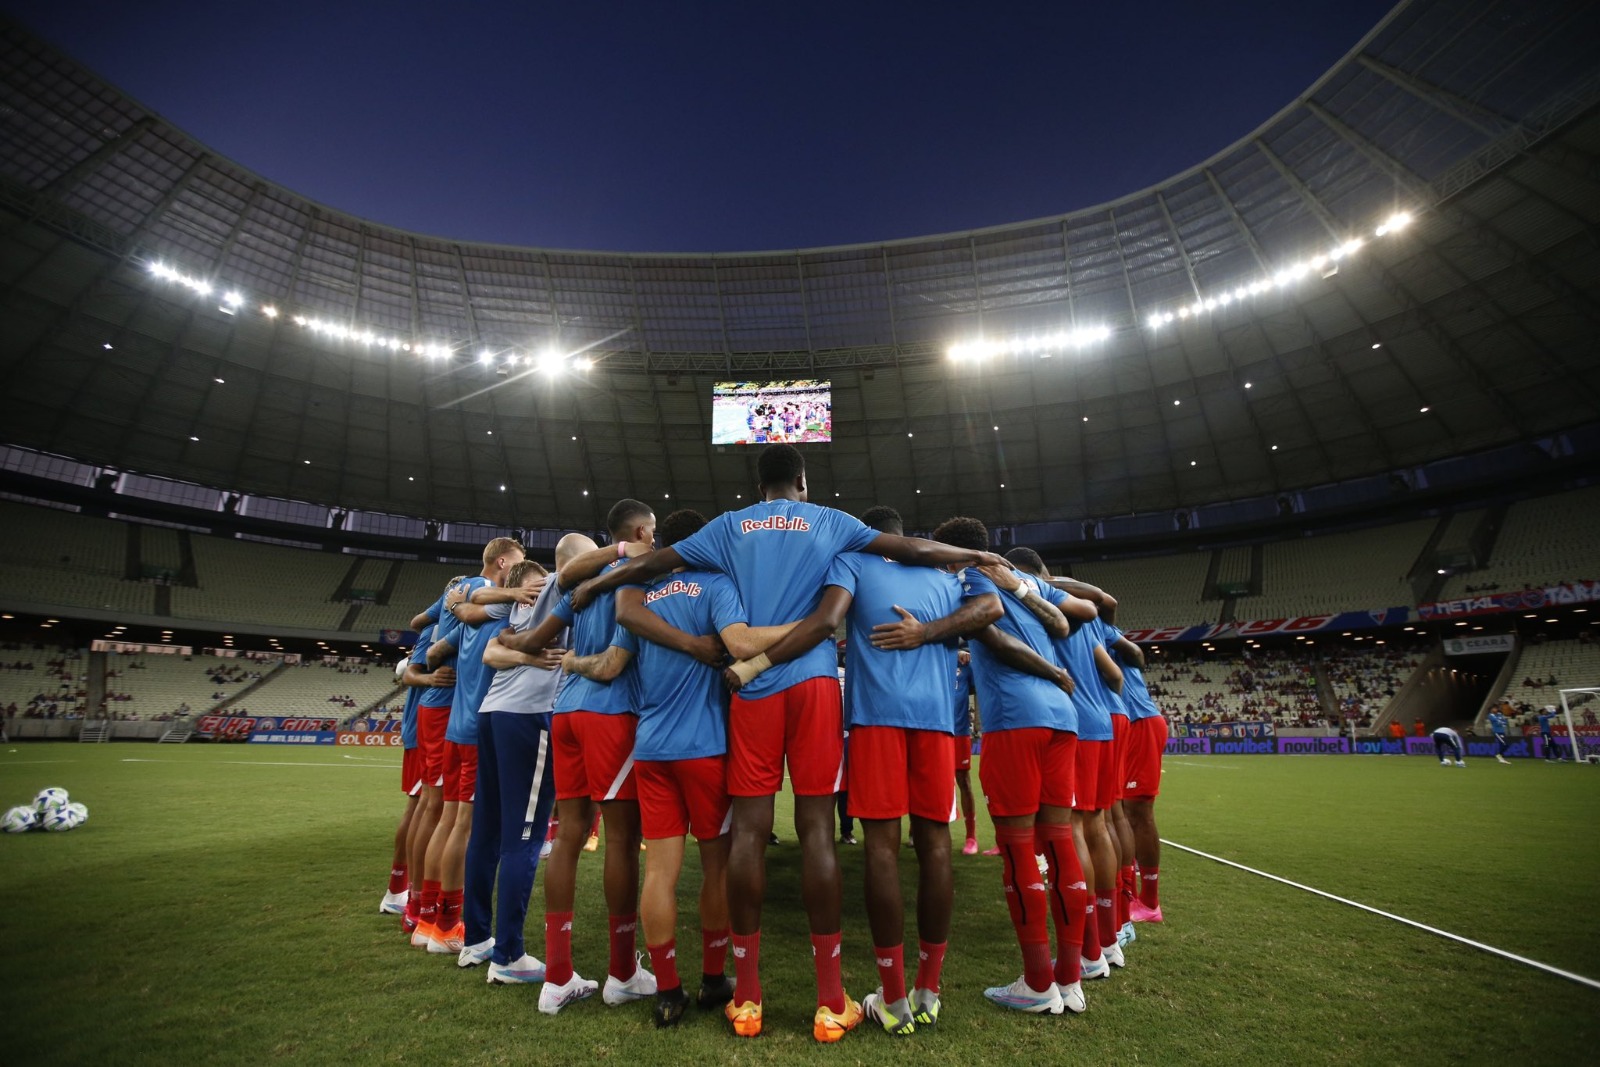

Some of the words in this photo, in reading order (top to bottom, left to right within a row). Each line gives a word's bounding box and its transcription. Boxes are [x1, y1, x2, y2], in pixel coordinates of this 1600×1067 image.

[1434, 596, 1501, 614] METAL
[339, 734, 361, 745] GOL
[365, 735, 386, 746] GOL
[1163, 738, 1207, 753] vibet
[1215, 738, 1273, 754] novibet
[1284, 738, 1348, 754] novibet
